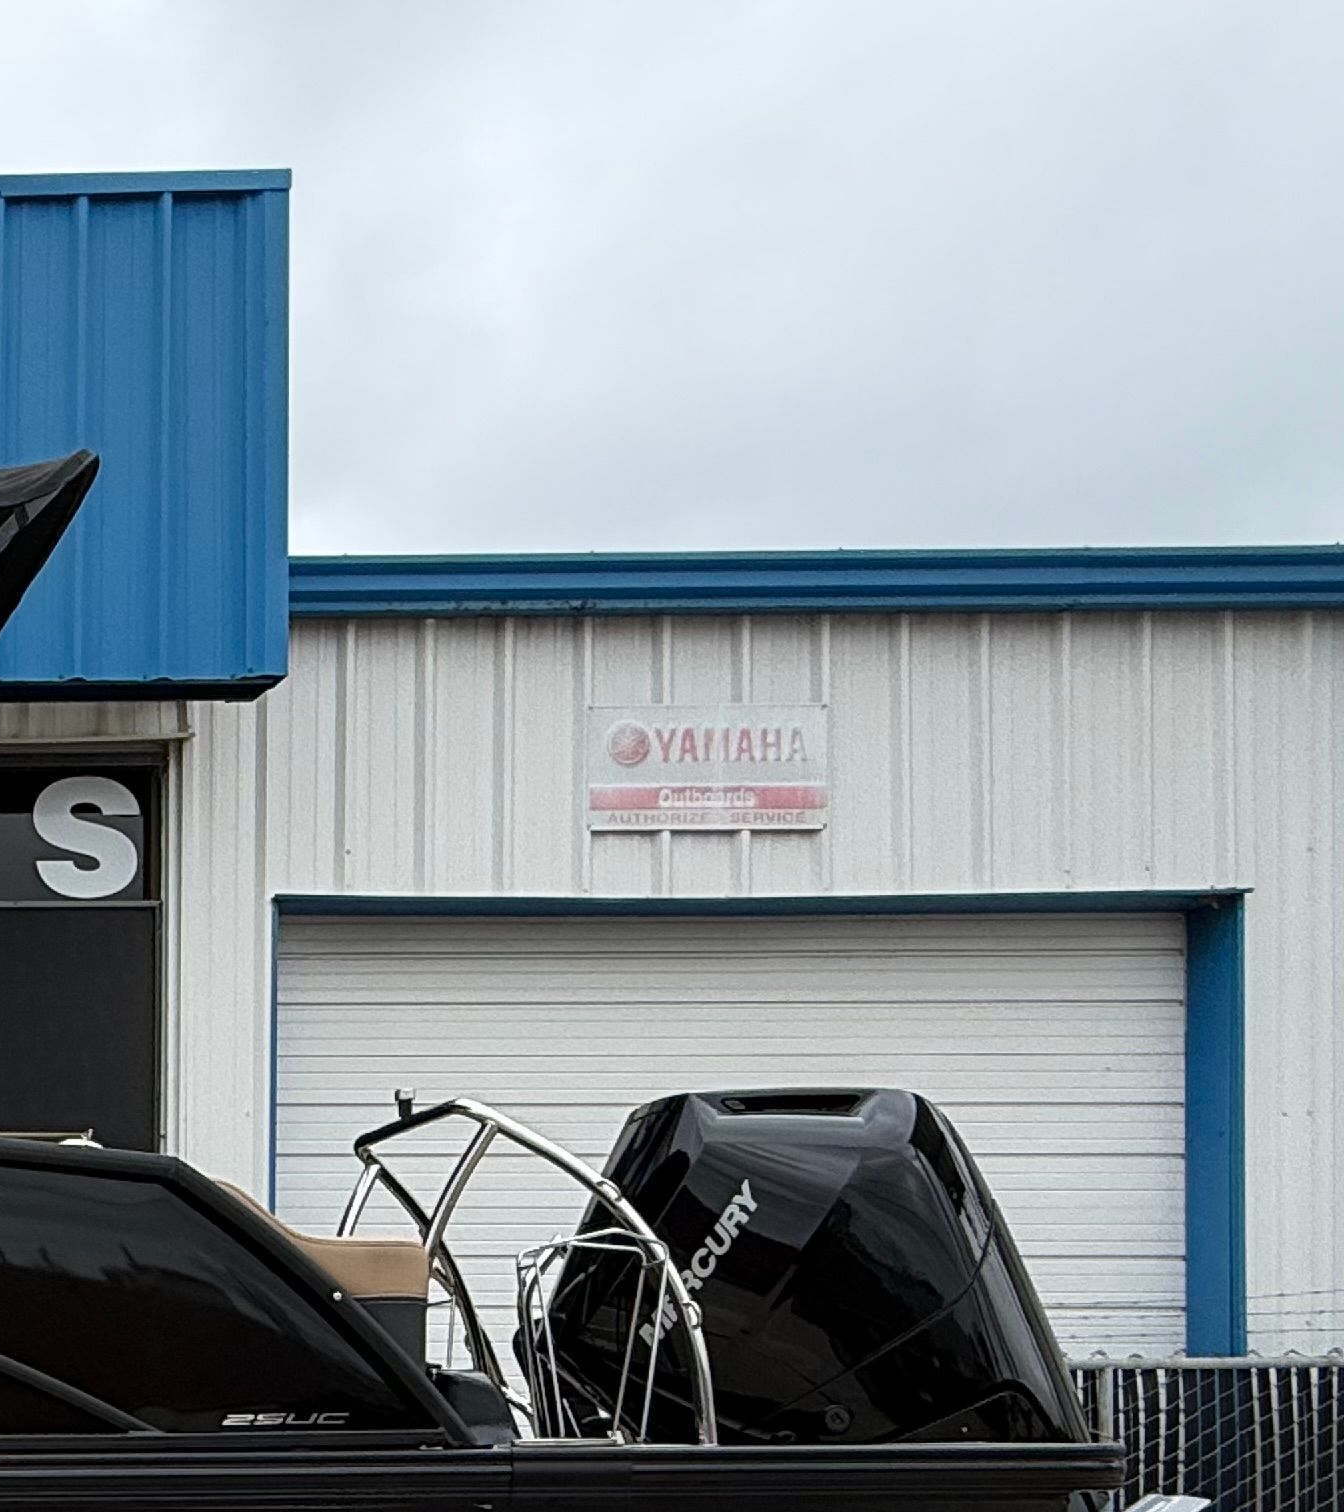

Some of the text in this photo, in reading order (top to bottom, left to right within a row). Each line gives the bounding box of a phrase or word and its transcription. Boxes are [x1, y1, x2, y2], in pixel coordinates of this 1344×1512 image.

[655, 726, 809, 763] YAMAHA
[608, 811, 807, 824] AUTHORIZE SERVICE
[221, 1412, 350, 1426] 25UC
